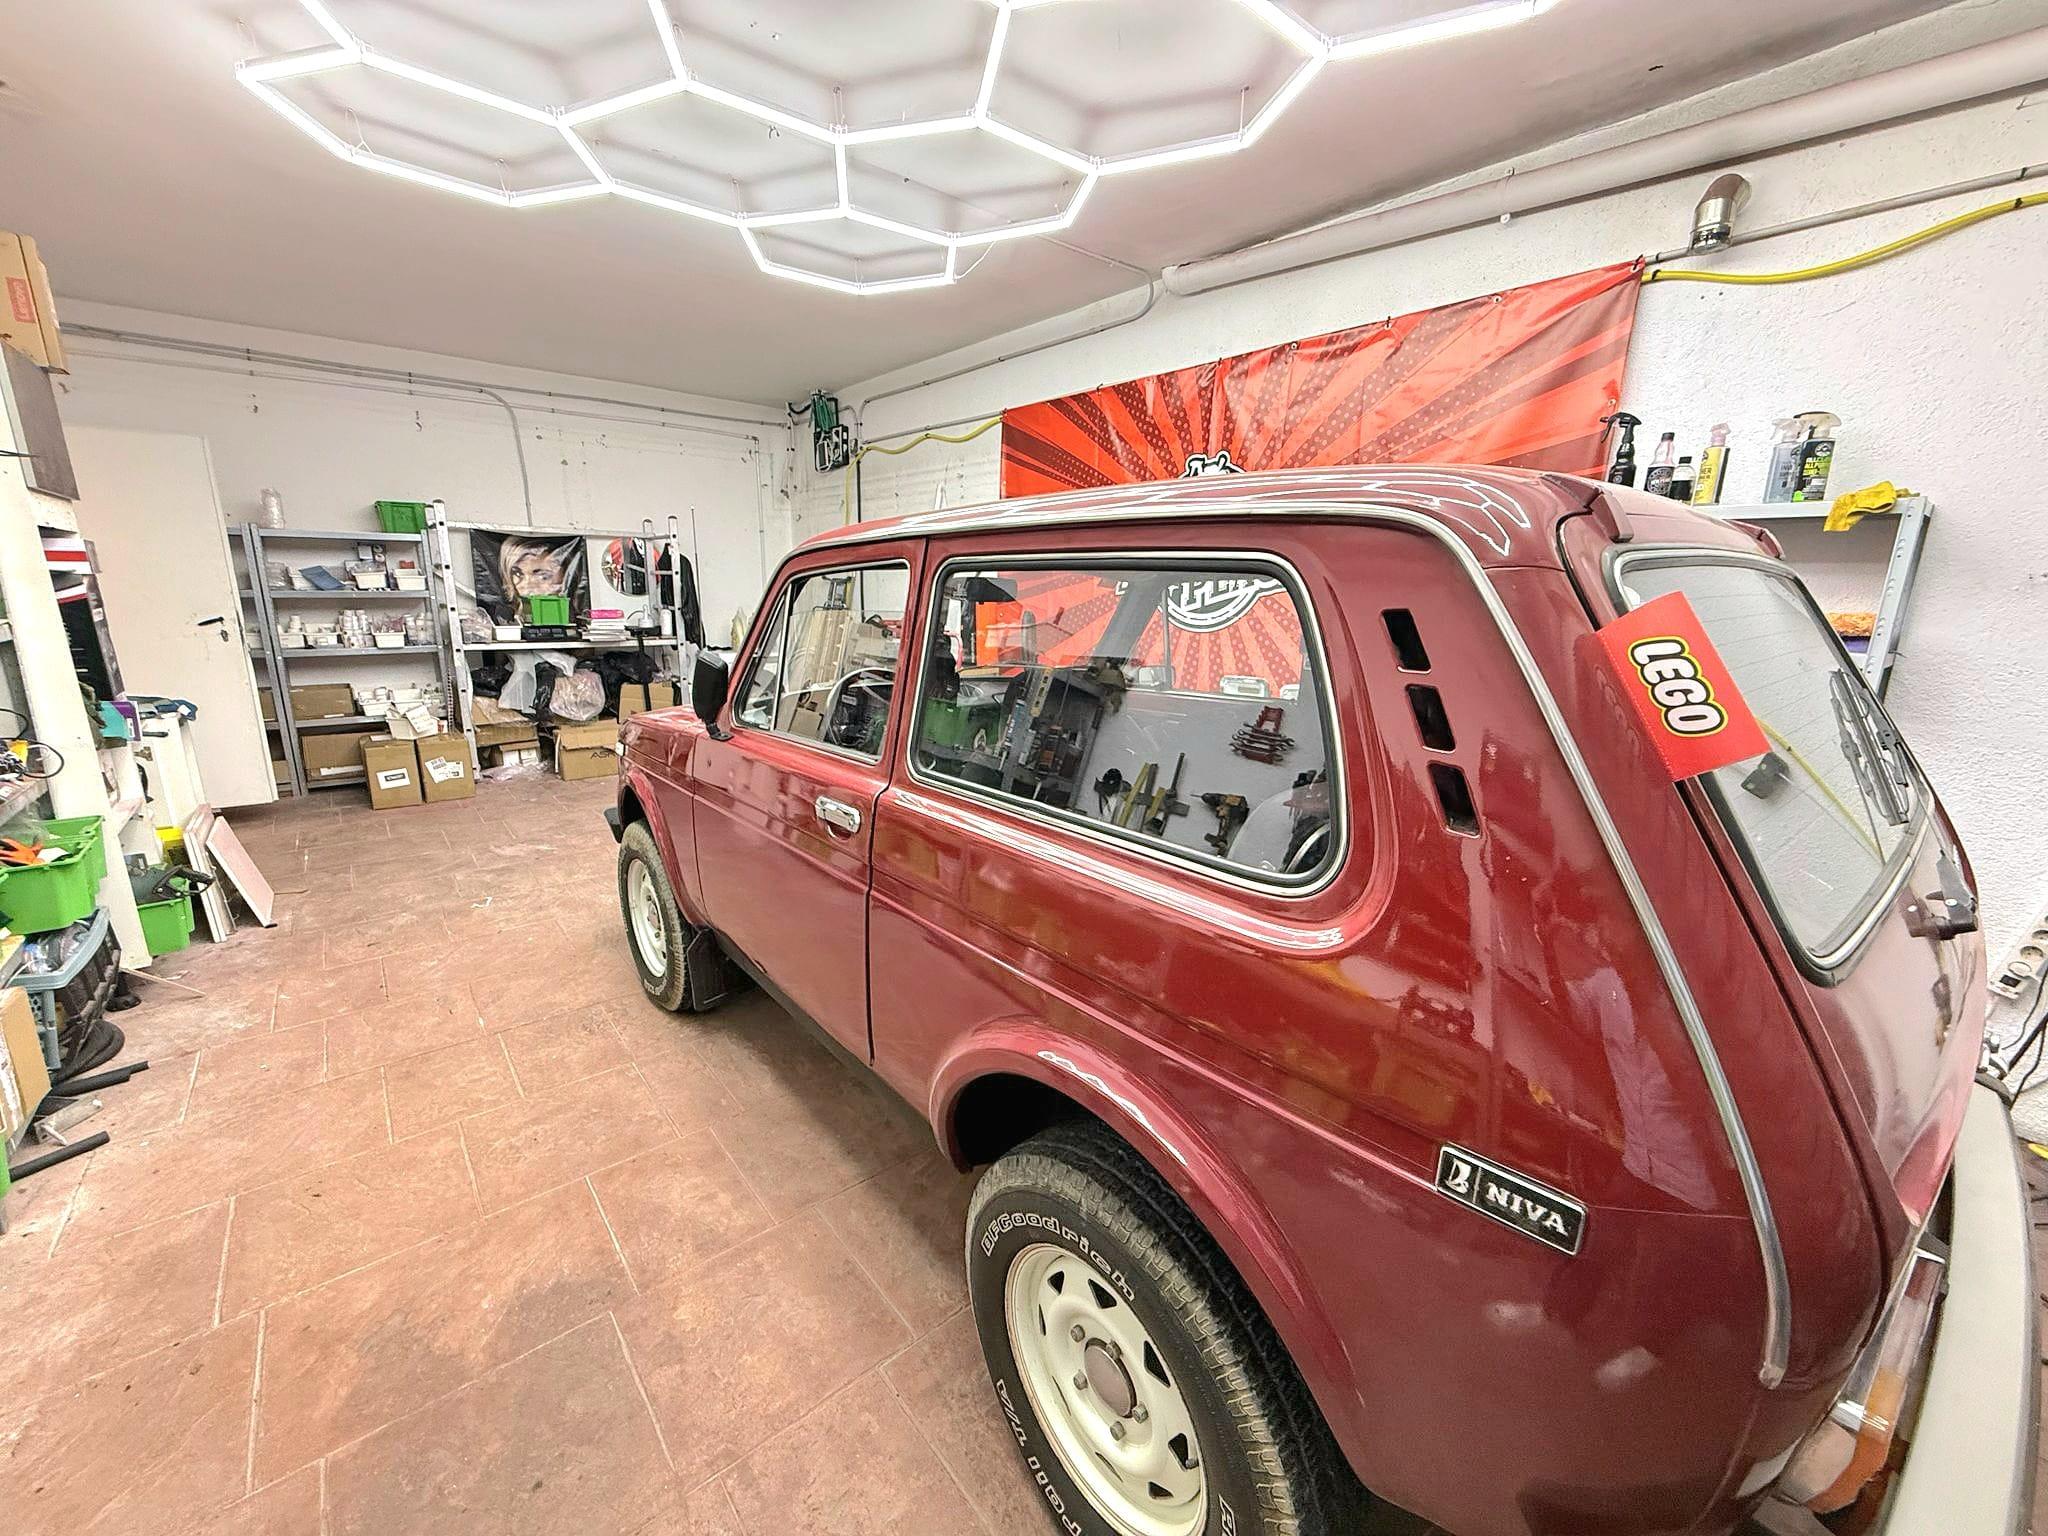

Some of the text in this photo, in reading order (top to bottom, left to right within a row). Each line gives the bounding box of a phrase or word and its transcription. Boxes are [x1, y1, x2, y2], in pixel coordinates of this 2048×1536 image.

[1630, 639, 1725, 734] LEGO
[1486, 1182, 1569, 1237] NIVA
[981, 1212, 1135, 1302] BFGoodrich
[997, 1379, 1026, 1447] T/A
